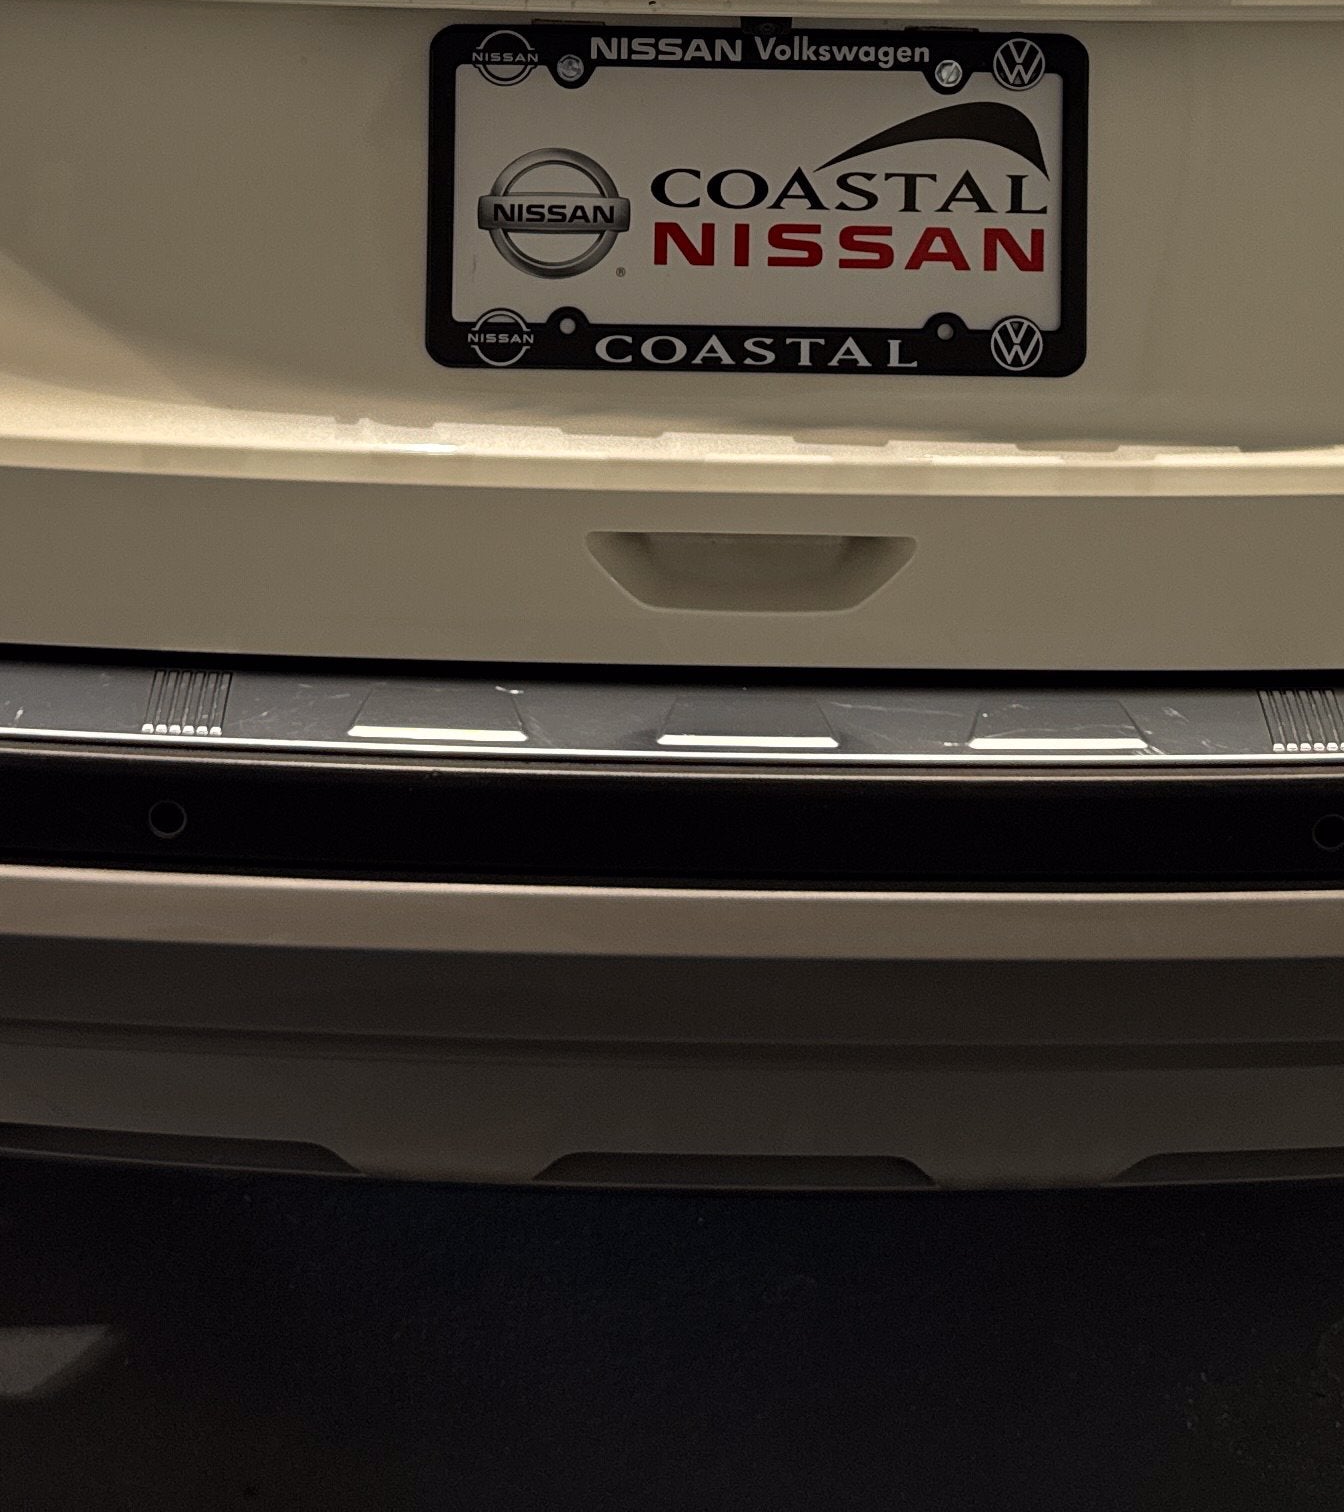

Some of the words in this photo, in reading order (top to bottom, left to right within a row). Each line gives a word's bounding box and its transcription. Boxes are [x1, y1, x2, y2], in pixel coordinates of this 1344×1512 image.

[472, 52, 538, 63] NISSAN
[590, 36, 742, 62] NISSAN
[754, 36, 931, 69] Volkswagen
[651, 167, 1047, 213] COASTAL
[493, 203, 615, 224] NISSAN
[654, 222, 1044, 271] NISSAN
[467, 332, 534, 344] NISSAN
[595, 334, 918, 368] COASTAL
